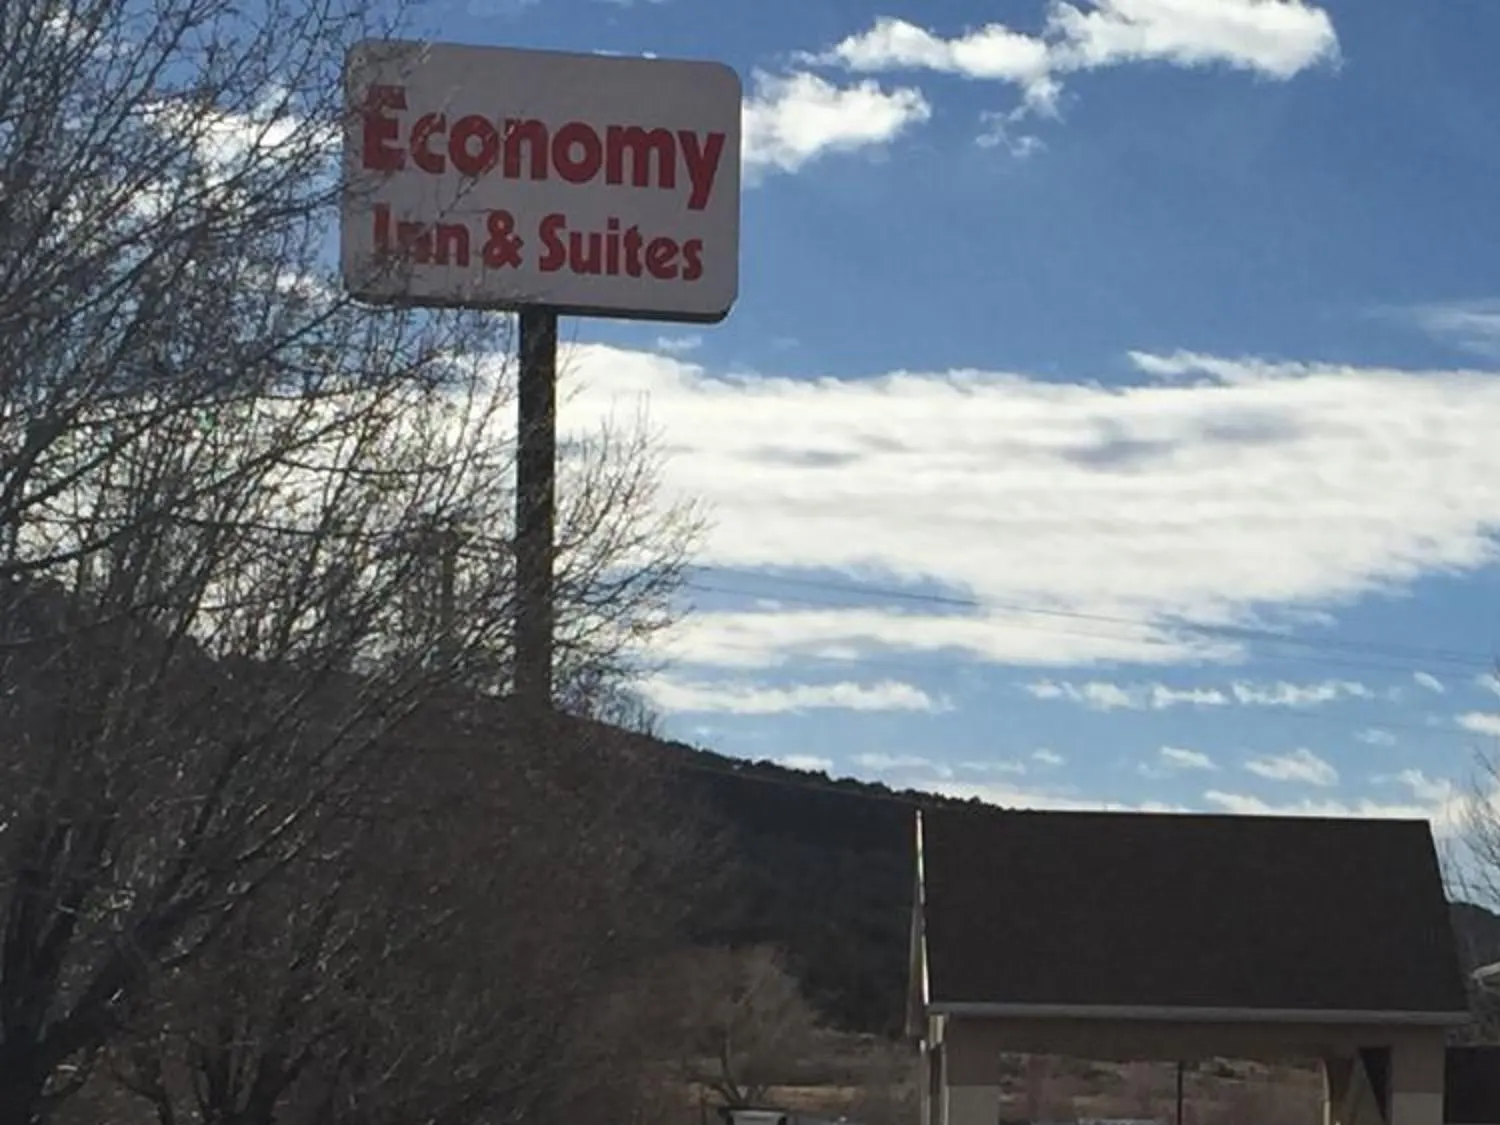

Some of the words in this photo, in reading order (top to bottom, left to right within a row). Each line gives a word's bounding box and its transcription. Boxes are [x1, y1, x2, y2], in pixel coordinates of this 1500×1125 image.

[362, 84, 726, 209] Economy
[373, 203, 470, 268] Inn
[483, 209, 525, 270] &
[538, 213, 705, 281] Suites
